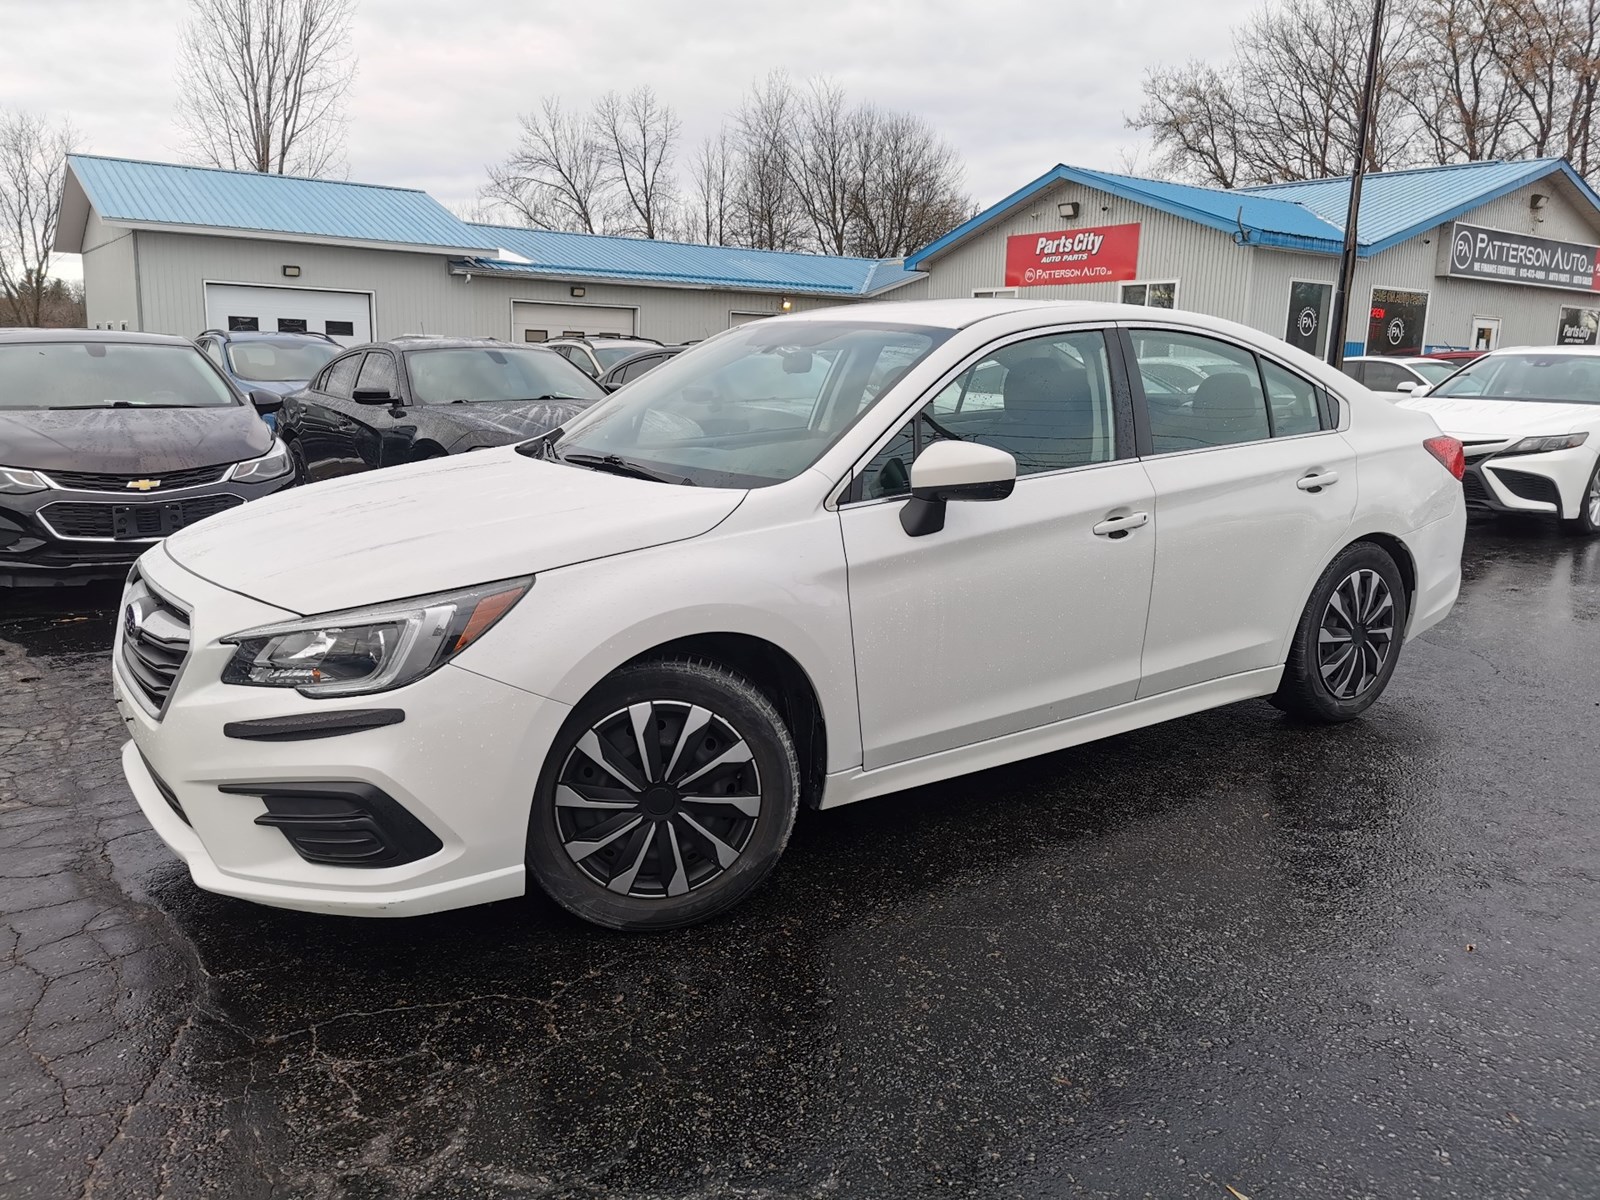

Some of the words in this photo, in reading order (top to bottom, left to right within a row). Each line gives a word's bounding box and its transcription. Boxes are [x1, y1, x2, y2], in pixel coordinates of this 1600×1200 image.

[1476, 234, 1550, 266] PATTERSON
[1036, 269, 1080, 279] PATTERSON
[1481, 263, 1497, 273] FINANCE
[1498, 265, 1516, 276] EVERYONE
[1549, 272, 1558, 281] AUTO
[1559, 274, 1569, 282] PARTS
